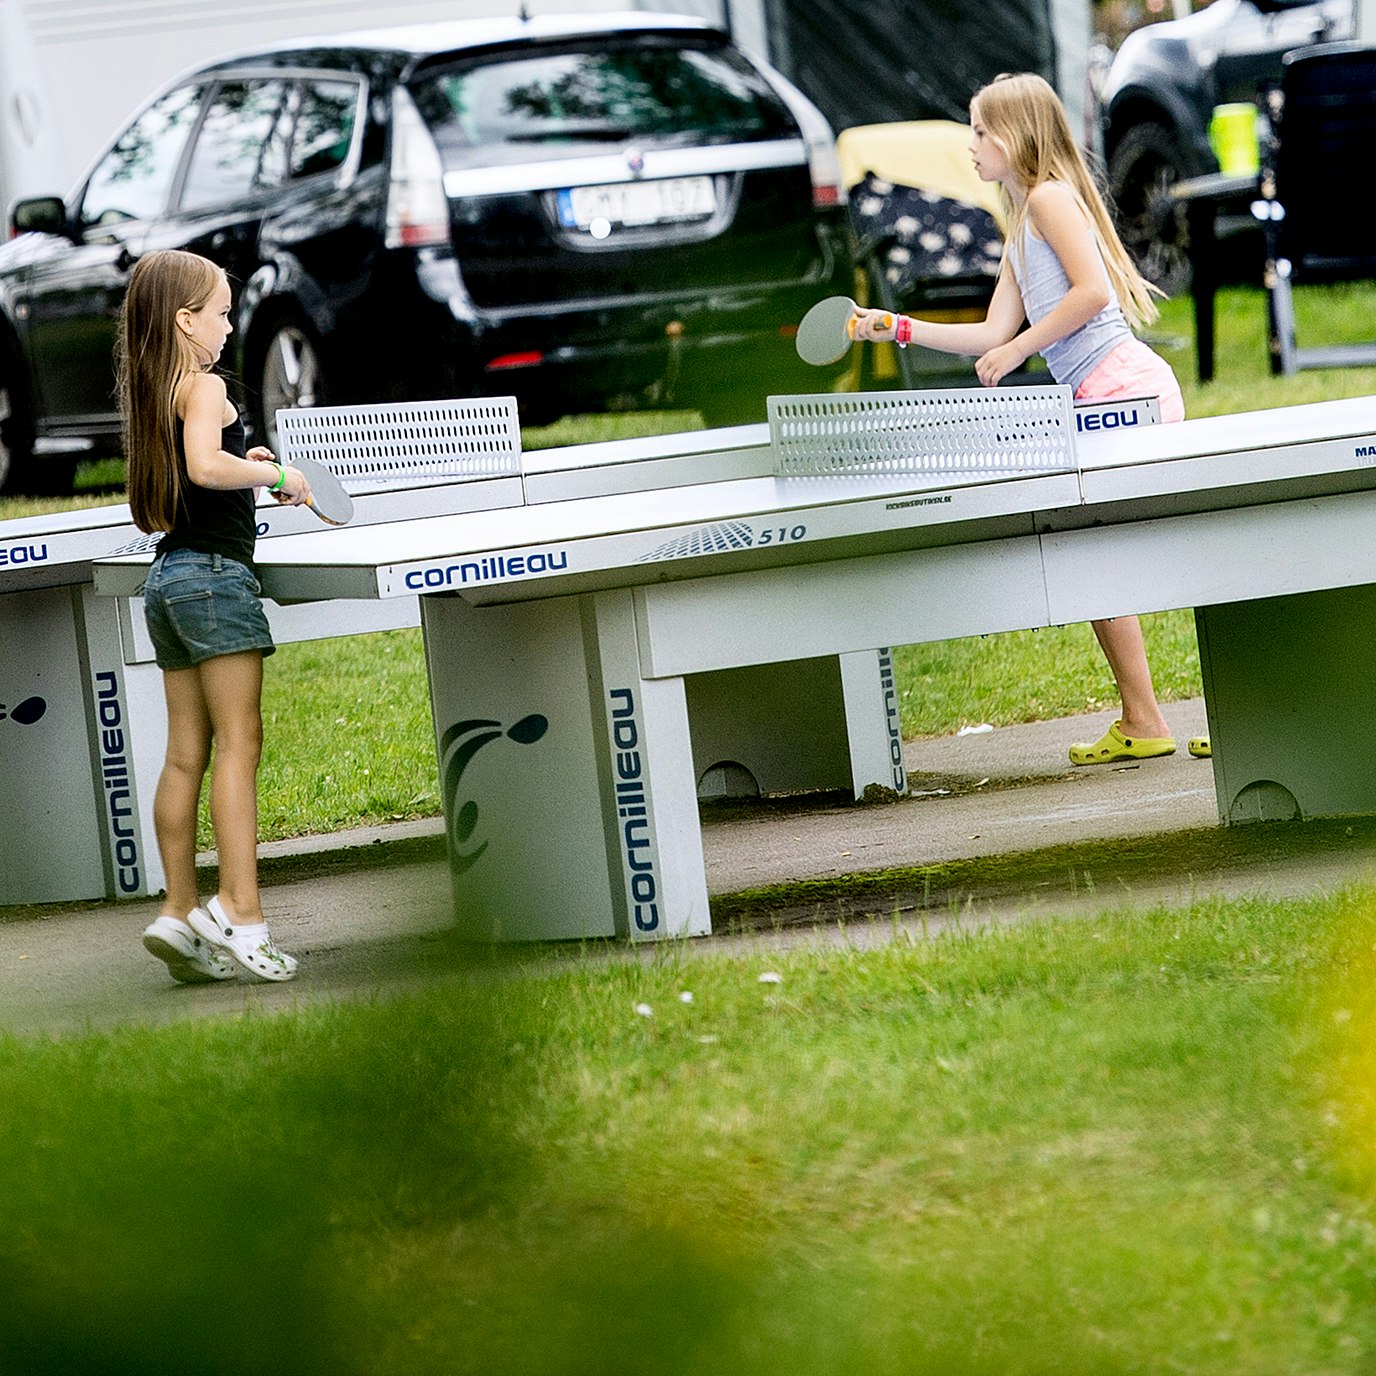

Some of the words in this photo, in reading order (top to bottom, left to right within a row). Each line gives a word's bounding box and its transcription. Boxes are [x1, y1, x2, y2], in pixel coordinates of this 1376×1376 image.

[405, 551, 567, 590] cornilleau
[758, 524, 807, 545] 510
[96, 671, 140, 893] cornilleau
[879, 647, 904, 792] cornill
[610, 688, 659, 932] cornilleau
